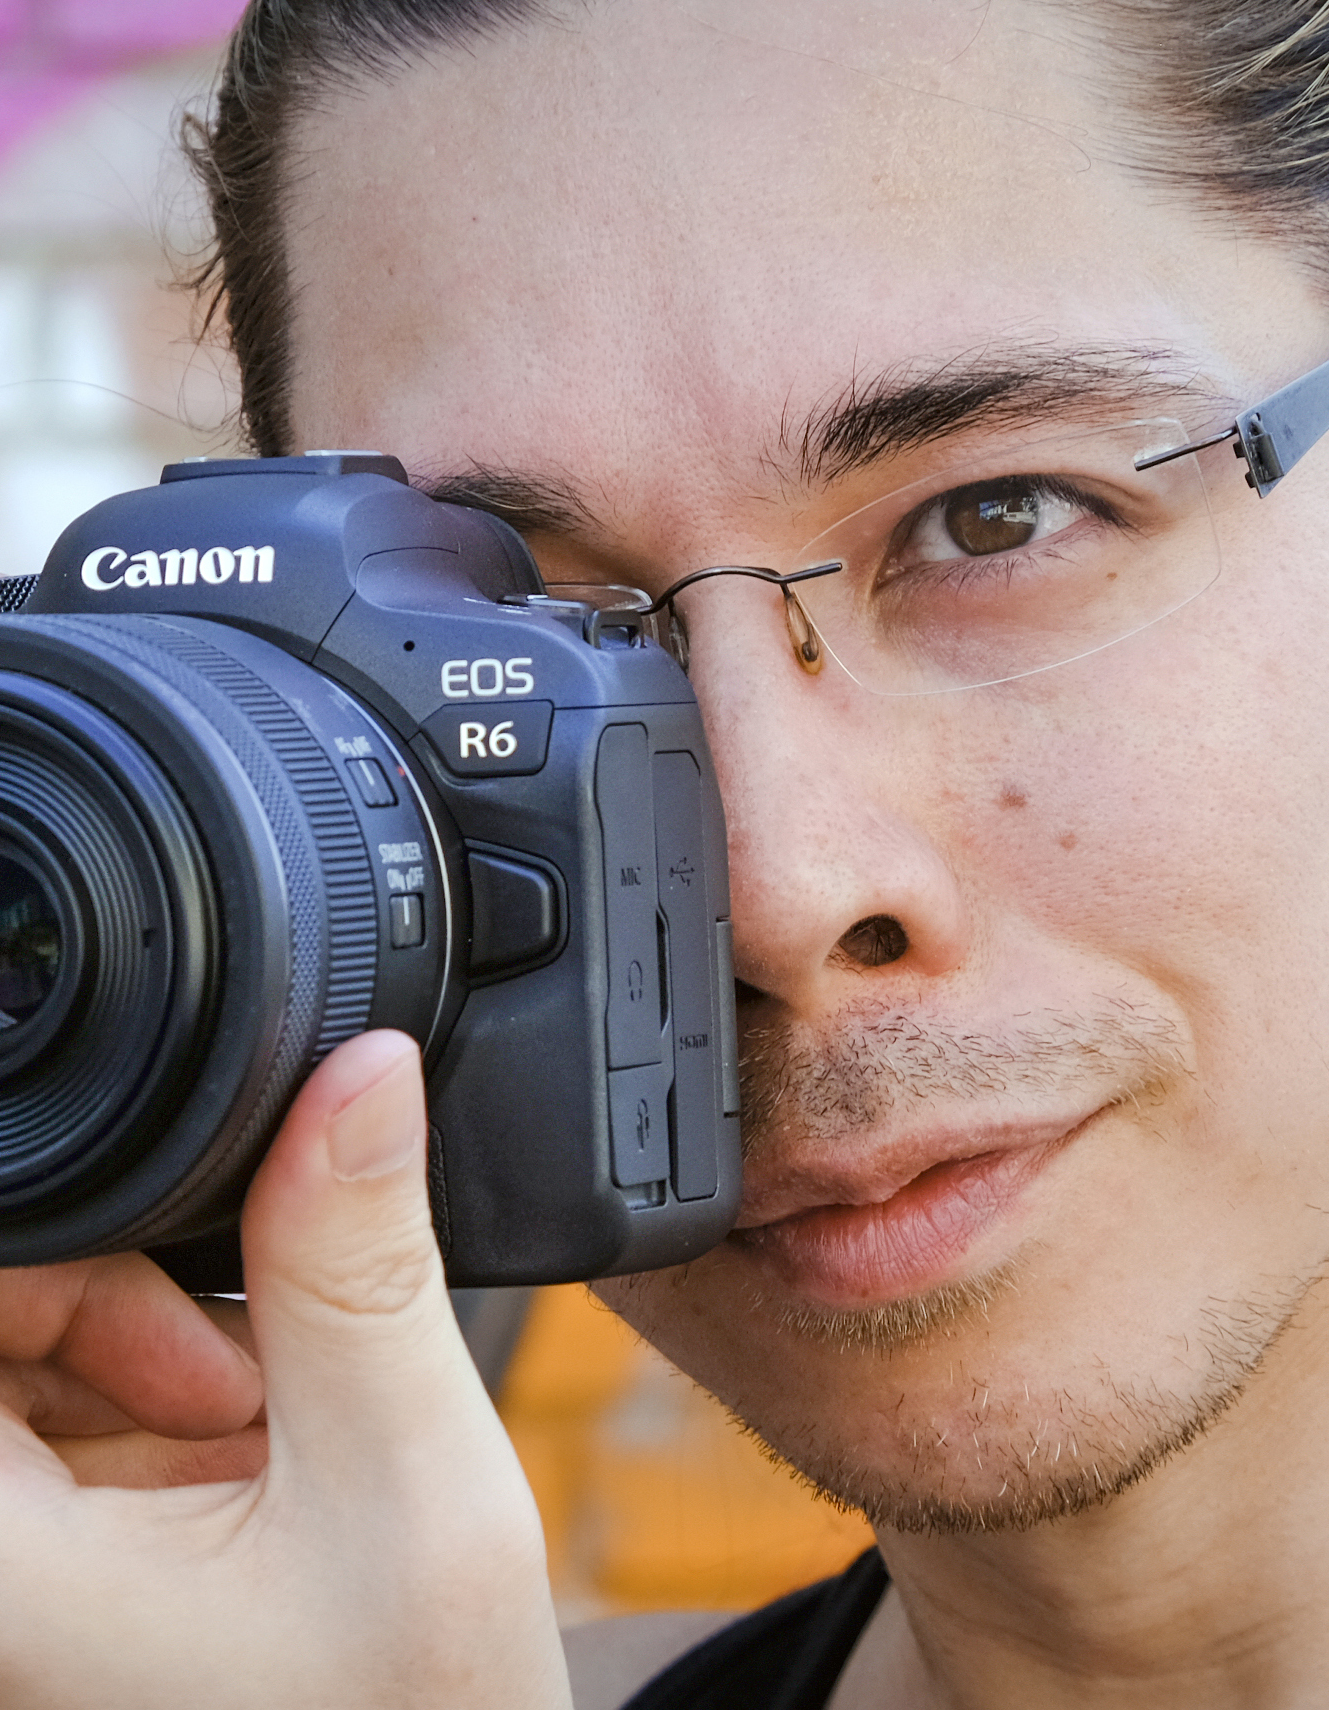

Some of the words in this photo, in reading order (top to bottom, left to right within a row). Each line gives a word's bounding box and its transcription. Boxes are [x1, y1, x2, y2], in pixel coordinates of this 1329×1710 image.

[81, 545, 275, 591] Canon
[441, 658, 534, 698] EOS
[460, 721, 517, 758] R6
